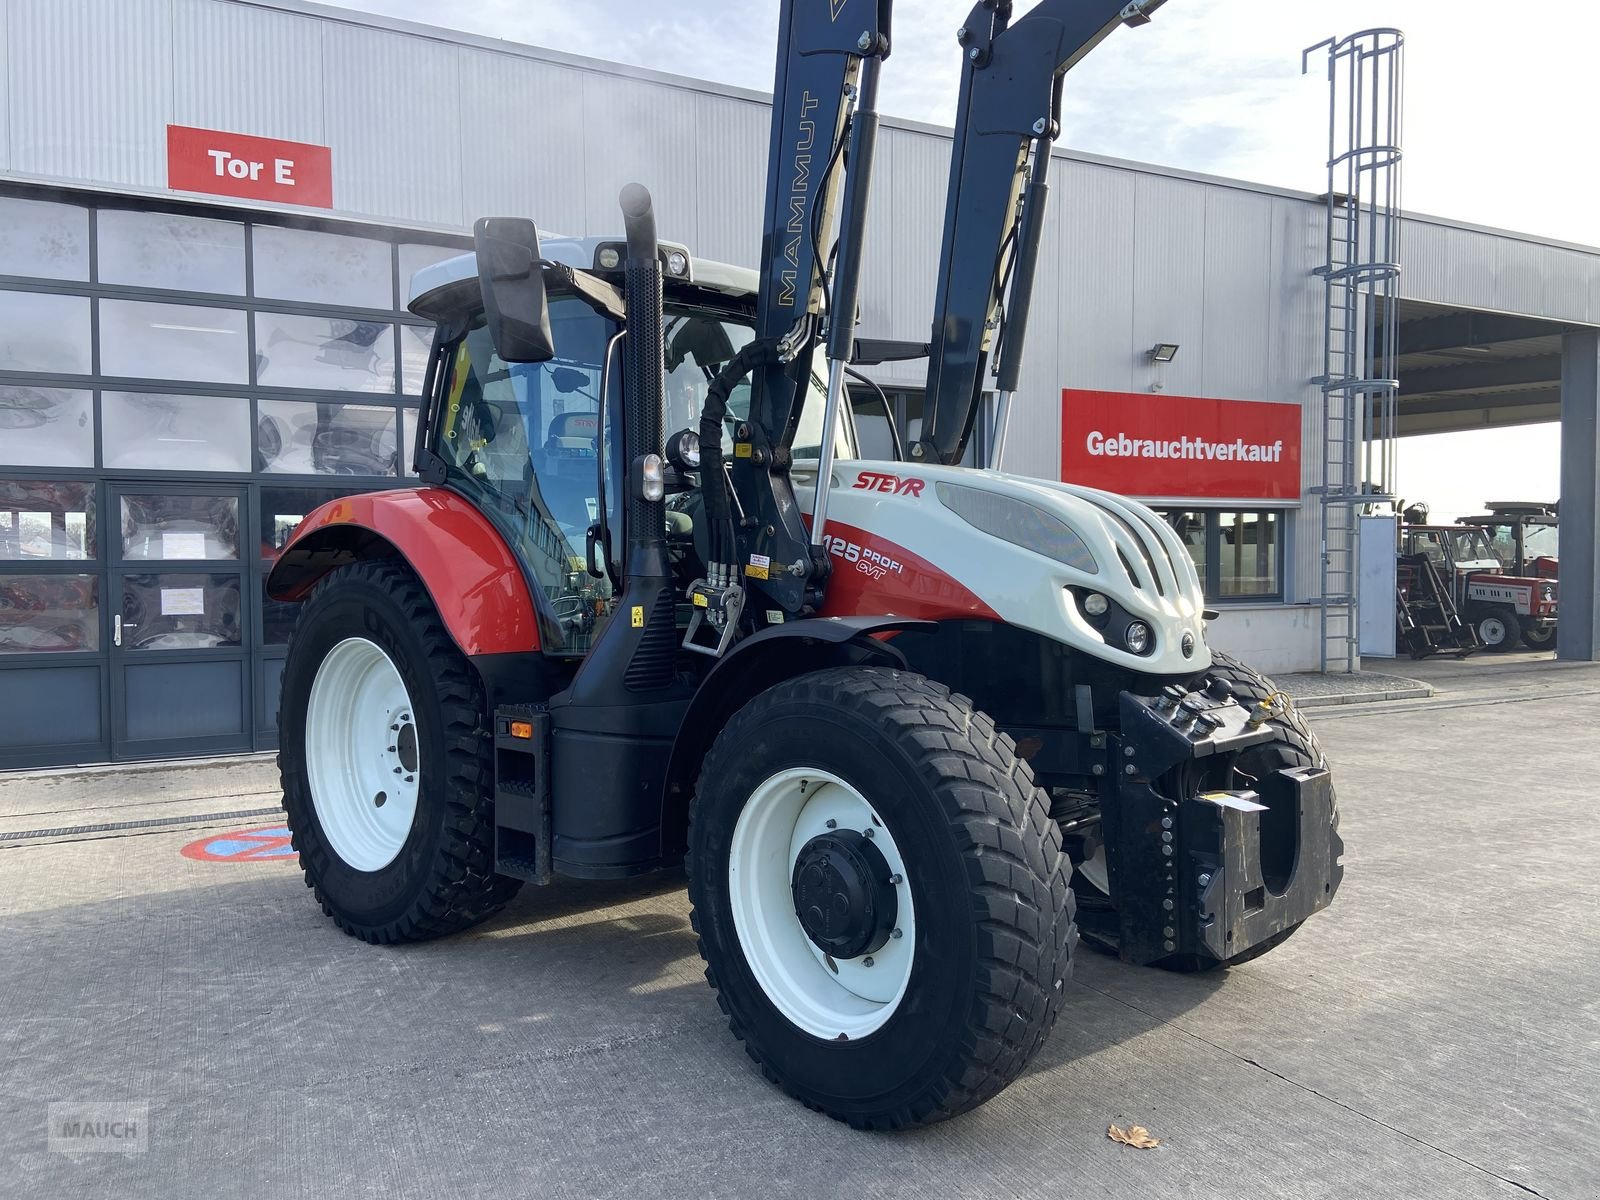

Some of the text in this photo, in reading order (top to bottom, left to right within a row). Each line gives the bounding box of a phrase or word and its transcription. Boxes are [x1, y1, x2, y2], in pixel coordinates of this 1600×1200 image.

[207, 149, 296, 186] Tor E
[778, 91, 818, 306] MAMMUT
[1086, 430, 1283, 463] Gebrauchtverkauf
[851, 471, 926, 498] STEYR
[855, 559, 887, 580] CVT
[862, 548, 904, 574] PROFI
